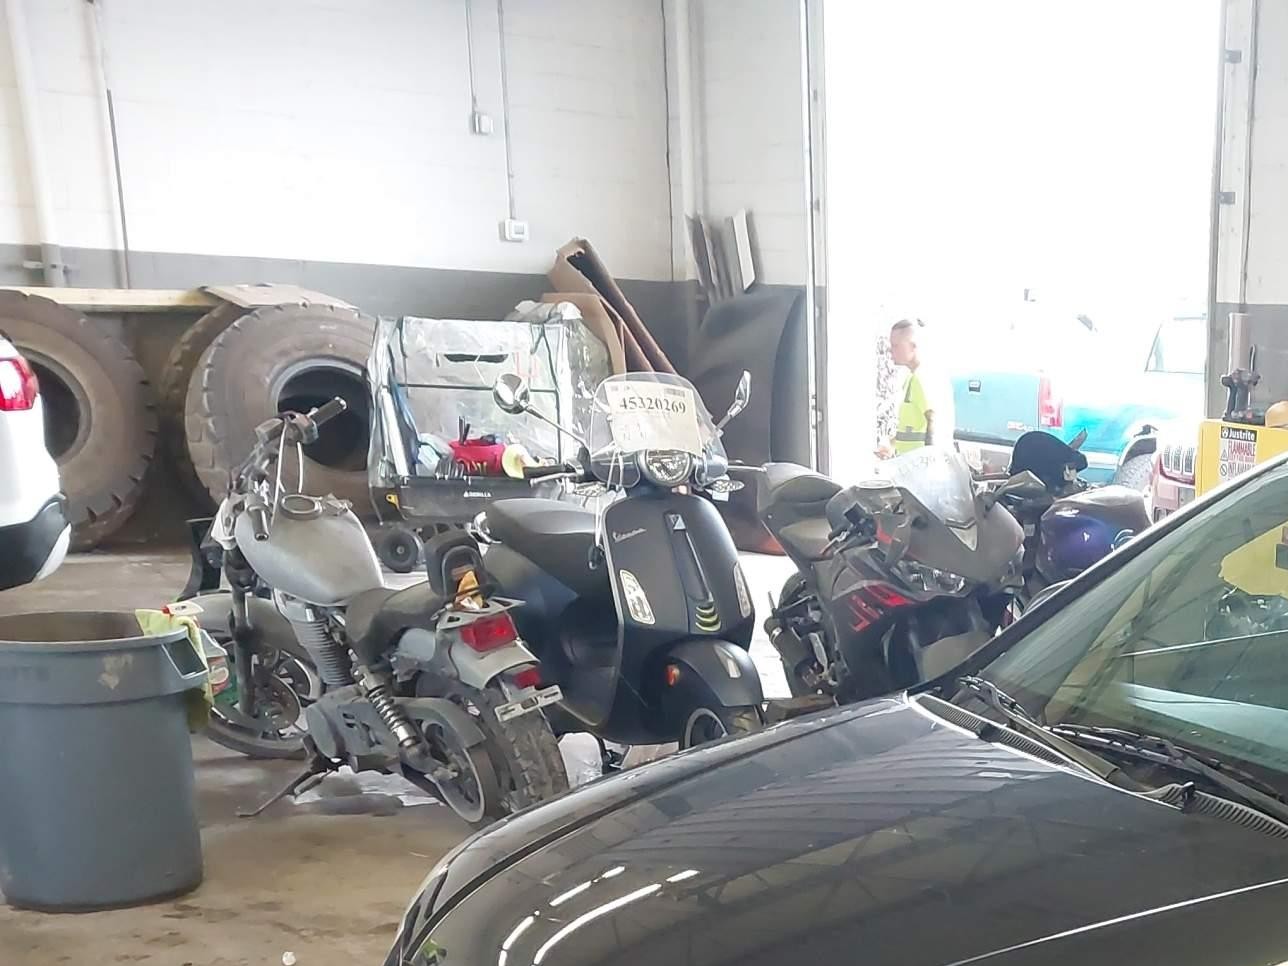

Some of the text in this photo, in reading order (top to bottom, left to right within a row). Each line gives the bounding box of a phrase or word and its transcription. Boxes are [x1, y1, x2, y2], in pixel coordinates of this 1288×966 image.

[620, 396, 686, 413] 45320269
[1229, 428, 1255, 441] Justrite
[1228, 440, 1256, 456] FLAMMABLE
